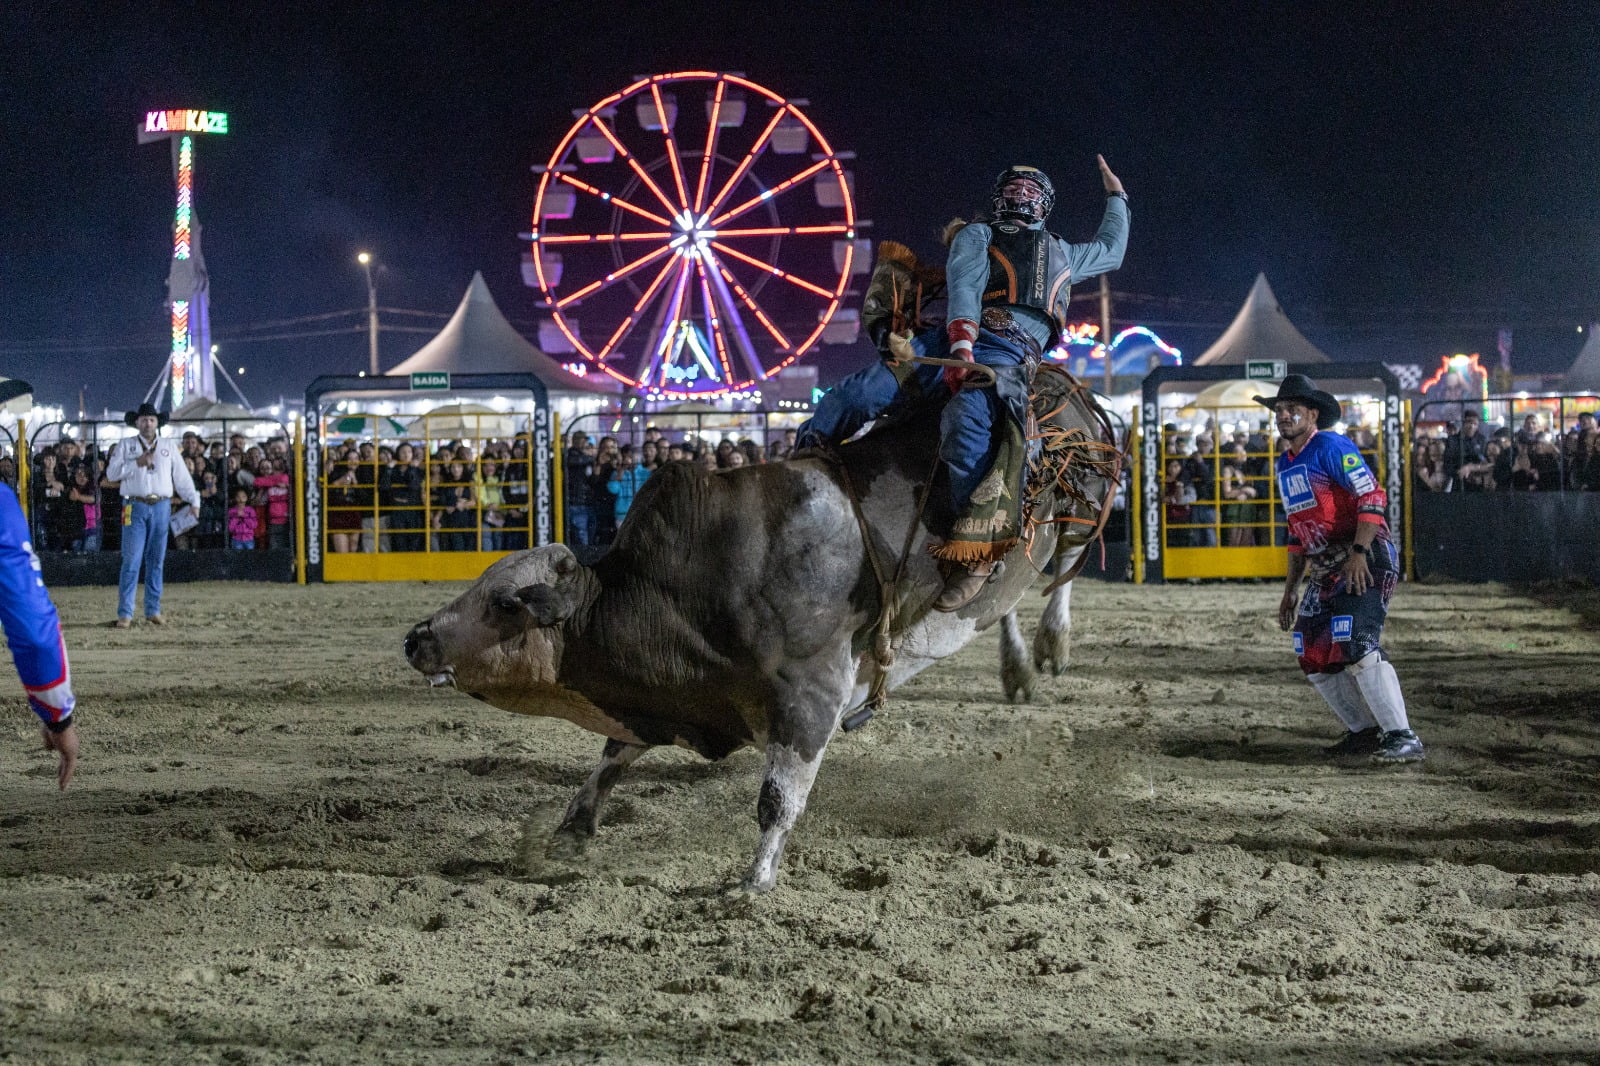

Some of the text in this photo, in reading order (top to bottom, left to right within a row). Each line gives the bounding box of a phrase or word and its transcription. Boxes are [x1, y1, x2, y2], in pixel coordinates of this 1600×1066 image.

[145, 109, 228, 134] KAMIKAZE
[413, 375, 448, 386] SAÍDA
[1145, 402, 1156, 421] 3
[1387, 395, 1399, 414] 3
[306, 411, 317, 427] 3
[536, 408, 547, 425] 3
